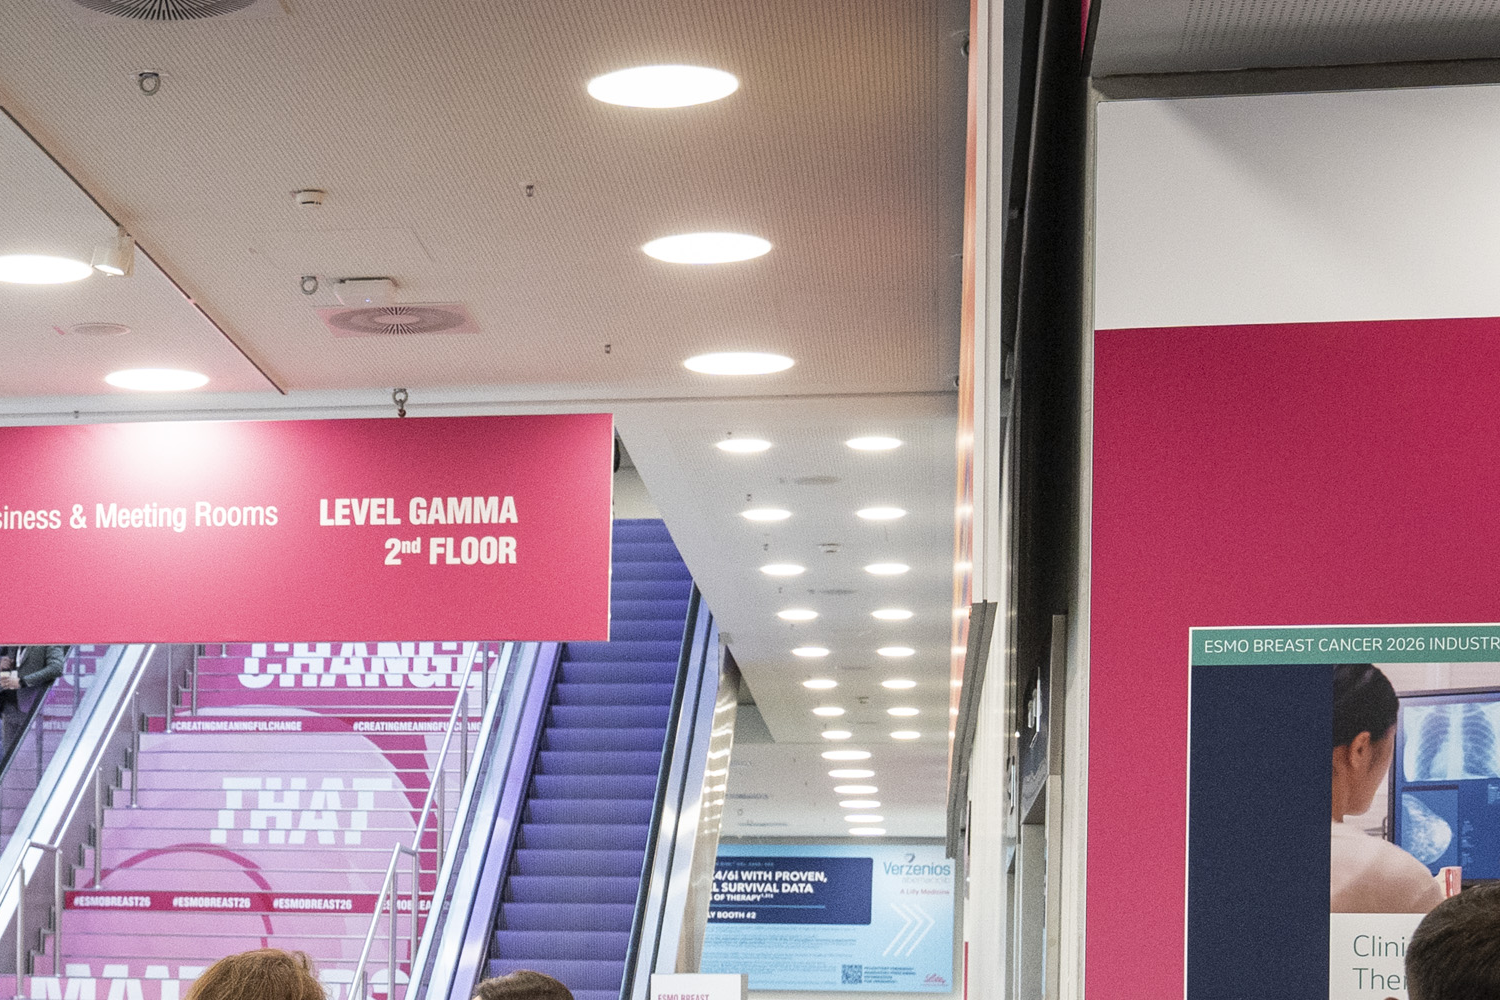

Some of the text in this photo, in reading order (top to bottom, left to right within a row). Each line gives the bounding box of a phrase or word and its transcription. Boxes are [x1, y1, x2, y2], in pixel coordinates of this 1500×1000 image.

[70, 505, 87, 530] &
[95, 503, 187, 532] Meeting
[195, 501, 278, 527] Rooms
[320, 496, 518, 526] LEVEL GAMMA
[385, 537, 518, 566] 2nd FLOOR
[1205, 636, 1500, 653] ESMO BREAST CANCER 2026 INDUSTR
[171, 720, 302, 732] #CREATINGMEANINGFULCHANGE
[210, 777, 392, 845] THAT
[883, 861, 951, 876] Verzenios
[740, 871, 828, 883] WITH PROVEN,
[721, 882, 779, 893] SURVIVAL
[781, 883, 814, 894] DATA
[73, 896, 352, 910] #ESMOBREAST26 #ESMOBREAST26 #ESMOBREAST26
[717, 911, 745, 919] BOOTH
[1353, 935, 1405, 957] Clini
